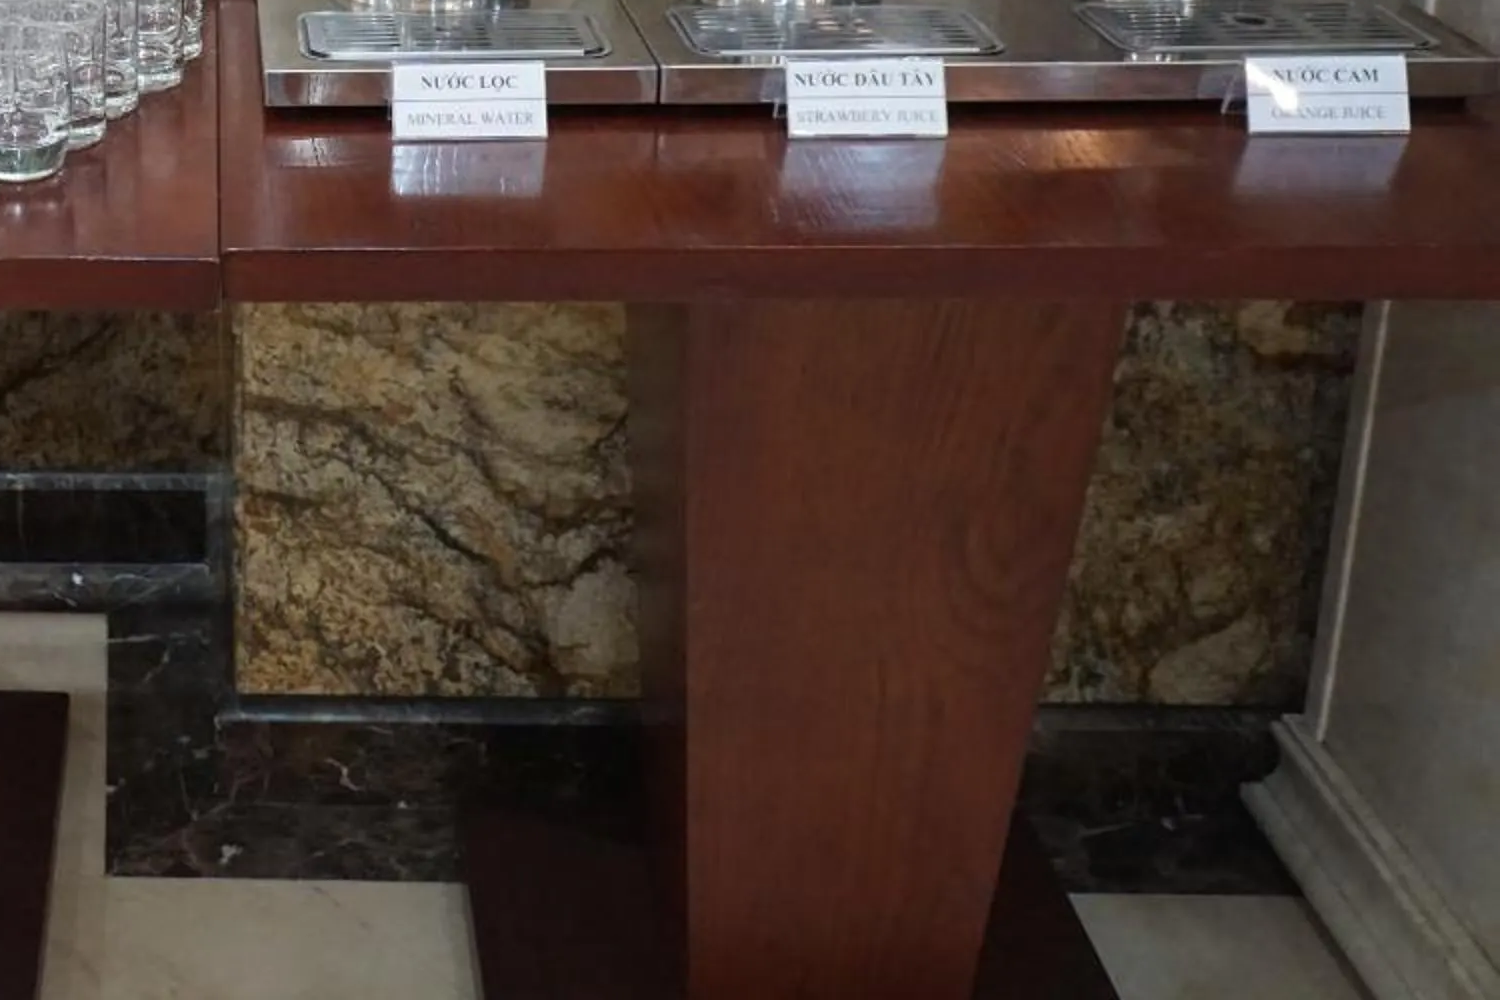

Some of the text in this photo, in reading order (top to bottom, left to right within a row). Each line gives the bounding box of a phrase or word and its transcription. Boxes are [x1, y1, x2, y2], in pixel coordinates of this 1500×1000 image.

[420, 71, 519, 92] NƯỚC LỌC
[793, 68, 850, 87] NƯỚC
[1333, 68, 1379, 83] CAM
[407, 111, 534, 127] MINERAL WATER
[1271, 105, 1389, 120] OANGE JUICE
